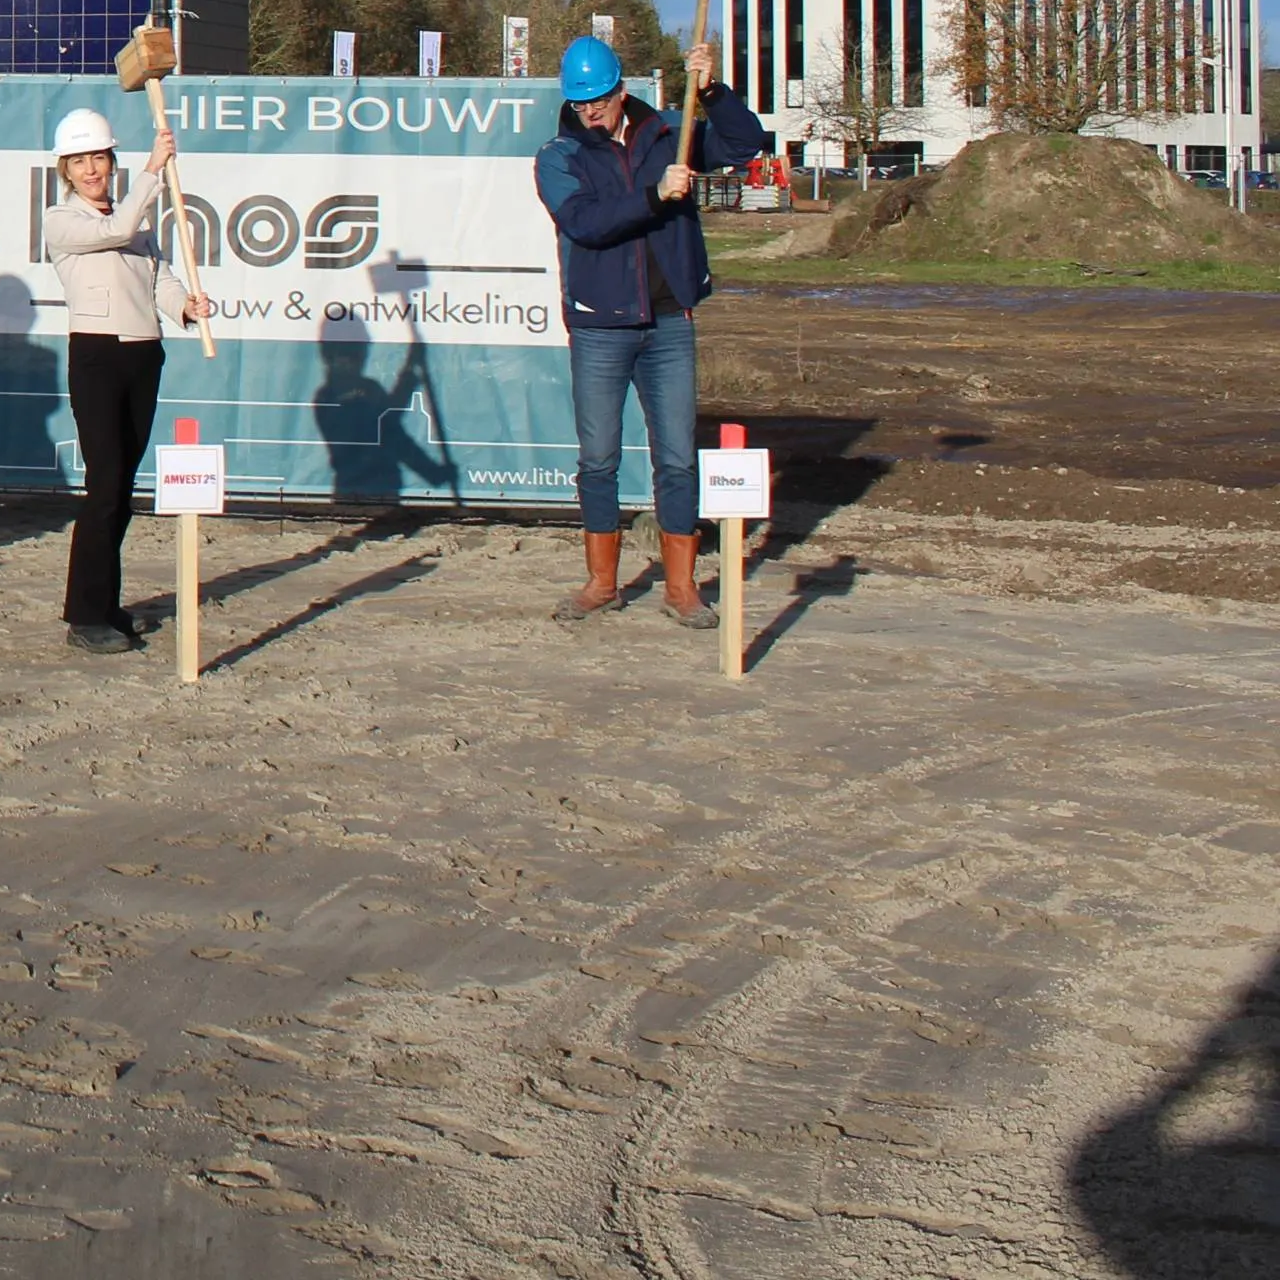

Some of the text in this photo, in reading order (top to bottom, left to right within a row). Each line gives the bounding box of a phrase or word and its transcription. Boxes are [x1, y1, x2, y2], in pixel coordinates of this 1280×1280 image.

[152, 95, 534, 133] HIER BOUWT
[284, 290, 311, 320] &
[324, 292, 549, 334] ontwikkeling
[164, 474, 202, 485] AMVEST
